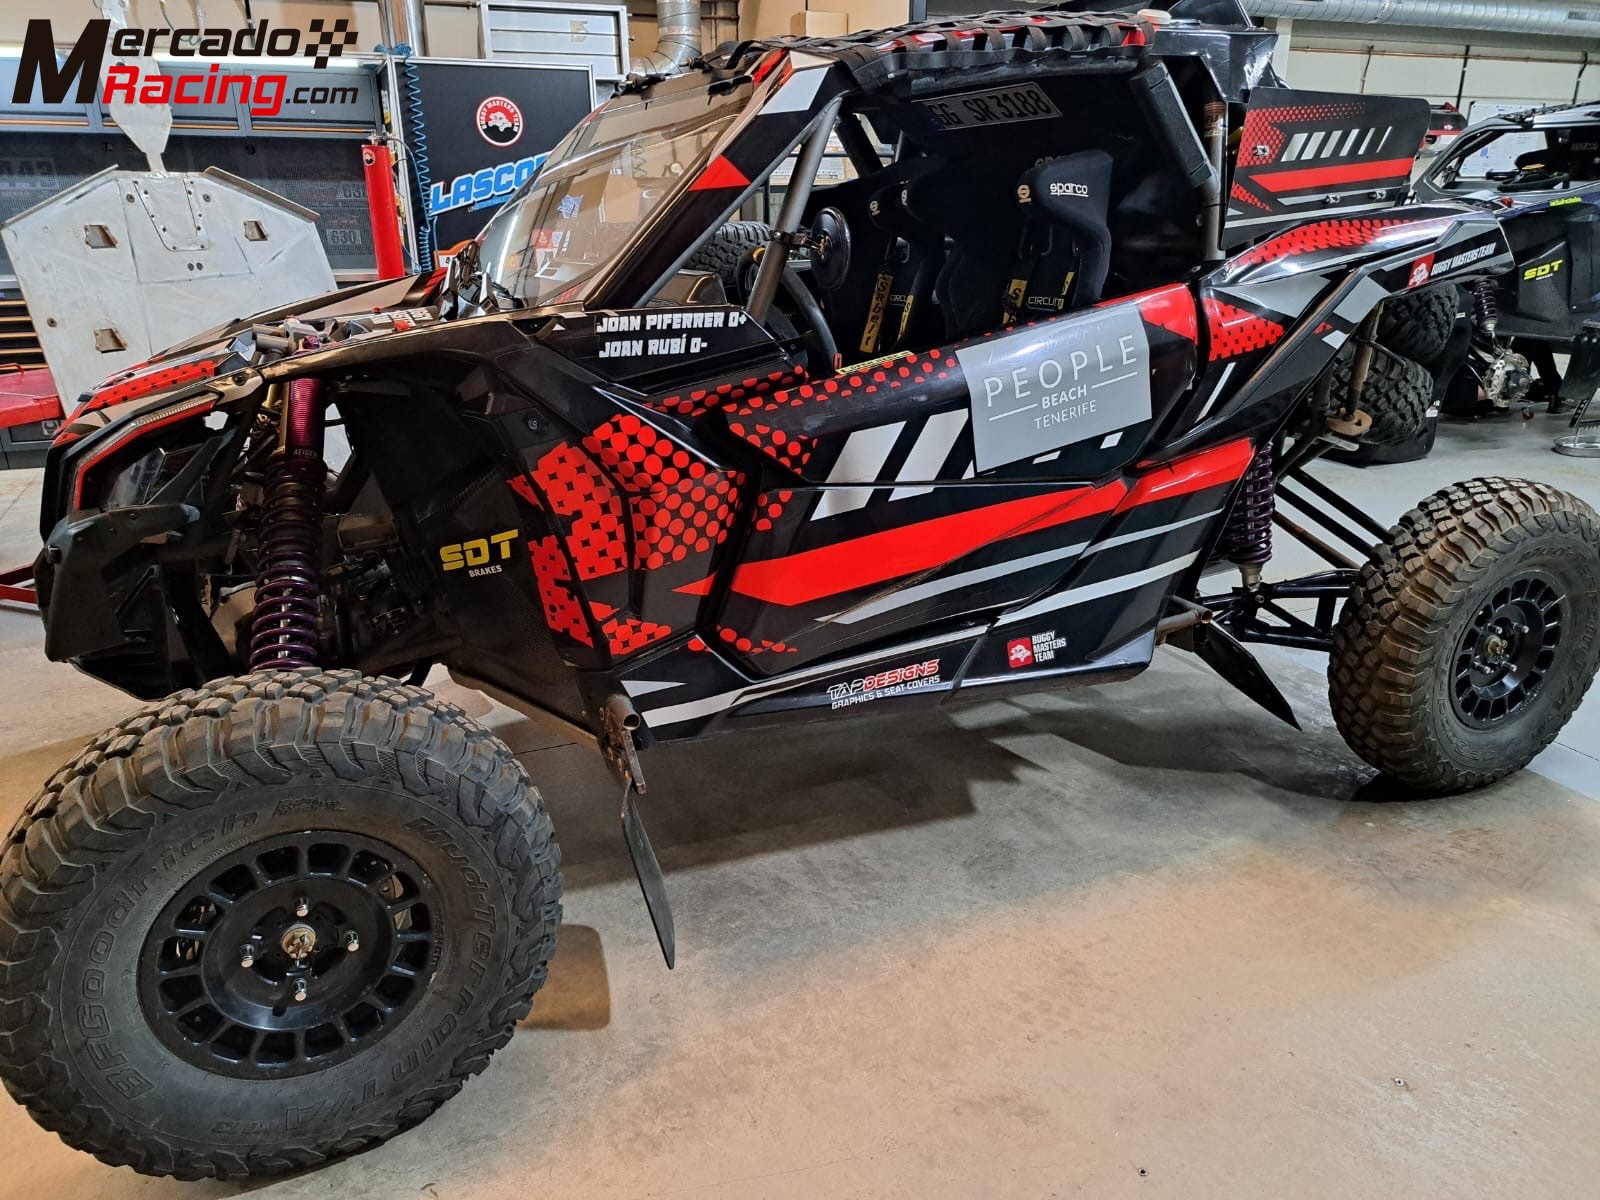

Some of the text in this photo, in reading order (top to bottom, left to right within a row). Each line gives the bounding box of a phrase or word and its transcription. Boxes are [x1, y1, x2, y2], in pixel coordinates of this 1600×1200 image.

[988, 89, 1051, 119] 3188
[1050, 182, 1088, 197] sparco
[1450, 248, 1479, 270] MASTERS
[1477, 242, 1497, 260] TEAM
[1523, 259, 1564, 281] SDT
[597, 315, 641, 333] JOAN
[644, 312, 724, 330] PIFERRER
[598, 339, 643, 359] JOAN
[647, 334, 687, 356] RUBÍ
[983, 334, 1138, 408] PEOPLE
[1041, 384, 1088, 410] BEACH
[1033, 400, 1098, 431] TENERIFE
[439, 528, 519, 571] SDT
[468, 564, 503, 578] BRAKES
[1031, 630, 1056, 645] BUGGY
[1032, 637, 1067, 655] MASTERS
[1033, 650, 1055, 664] TEAM
[831, 674, 941, 710] GRAPHICS & SEAT COVERS
[77, 810, 259, 1099] BFGoodrich
